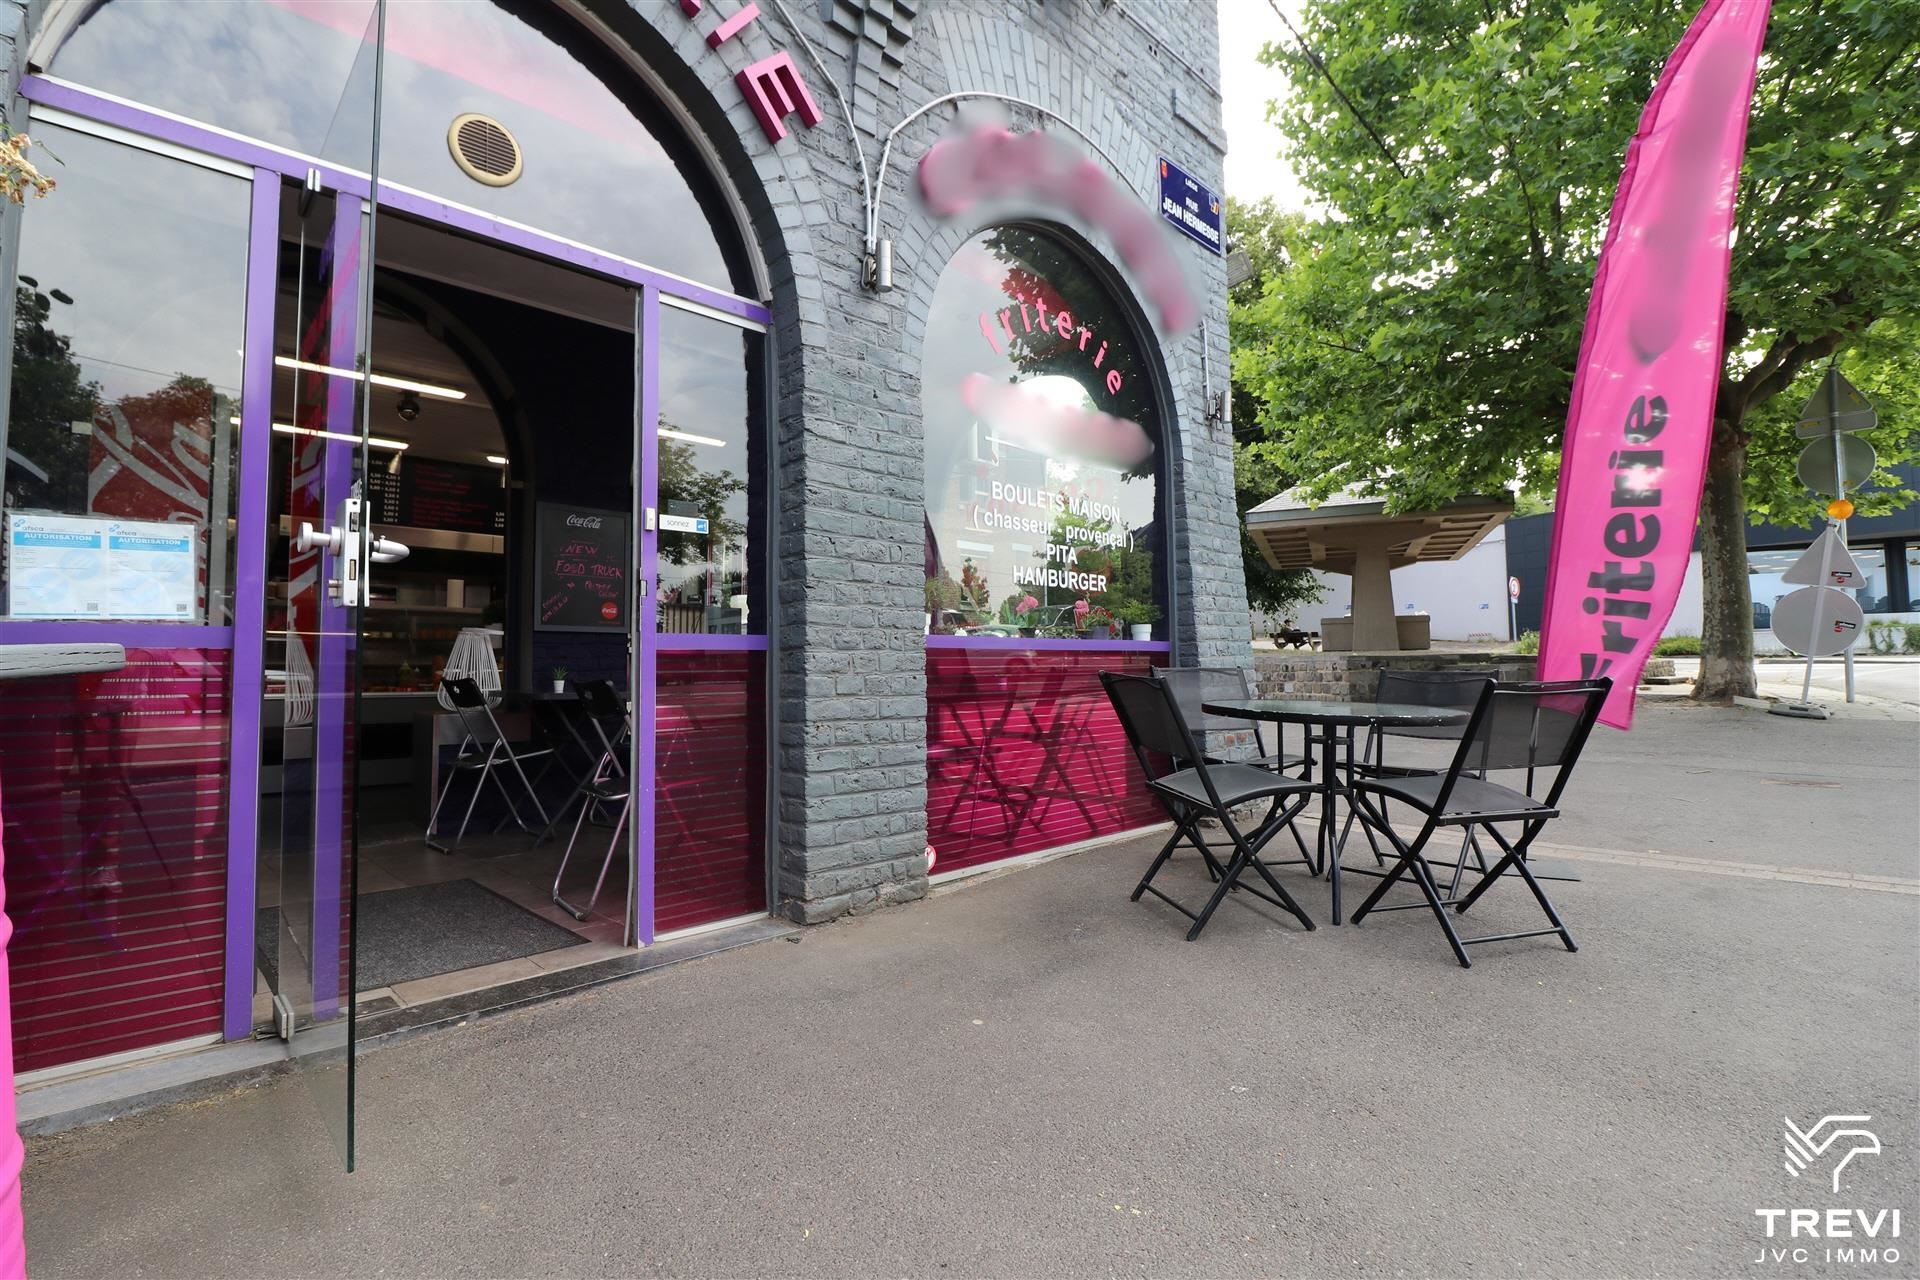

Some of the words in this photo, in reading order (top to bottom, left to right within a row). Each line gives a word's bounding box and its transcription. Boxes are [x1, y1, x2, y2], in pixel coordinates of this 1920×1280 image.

[1163, 197, 1182, 219] JEAN
[1183, 209, 1219, 243] HERMESSE
[979, 292, 1124, 396] friterie
[991, 481, 1065, 512] BOULETS
[1069, 497, 1121, 523] MAISON
[666, 519, 690, 528] sonnez
[984, 508, 1053, 536] chasseur
[24, 532, 92, 542] AUTORISATION
[117, 536, 181, 546] AUTORISATION
[565, 544, 599, 555] NEW
[1046, 543, 1078, 564] PITA
[555, 560, 585, 575] FOOD
[591, 564, 624, 578] TRUCK
[1012, 565, 1107, 592] HAMBURGER
